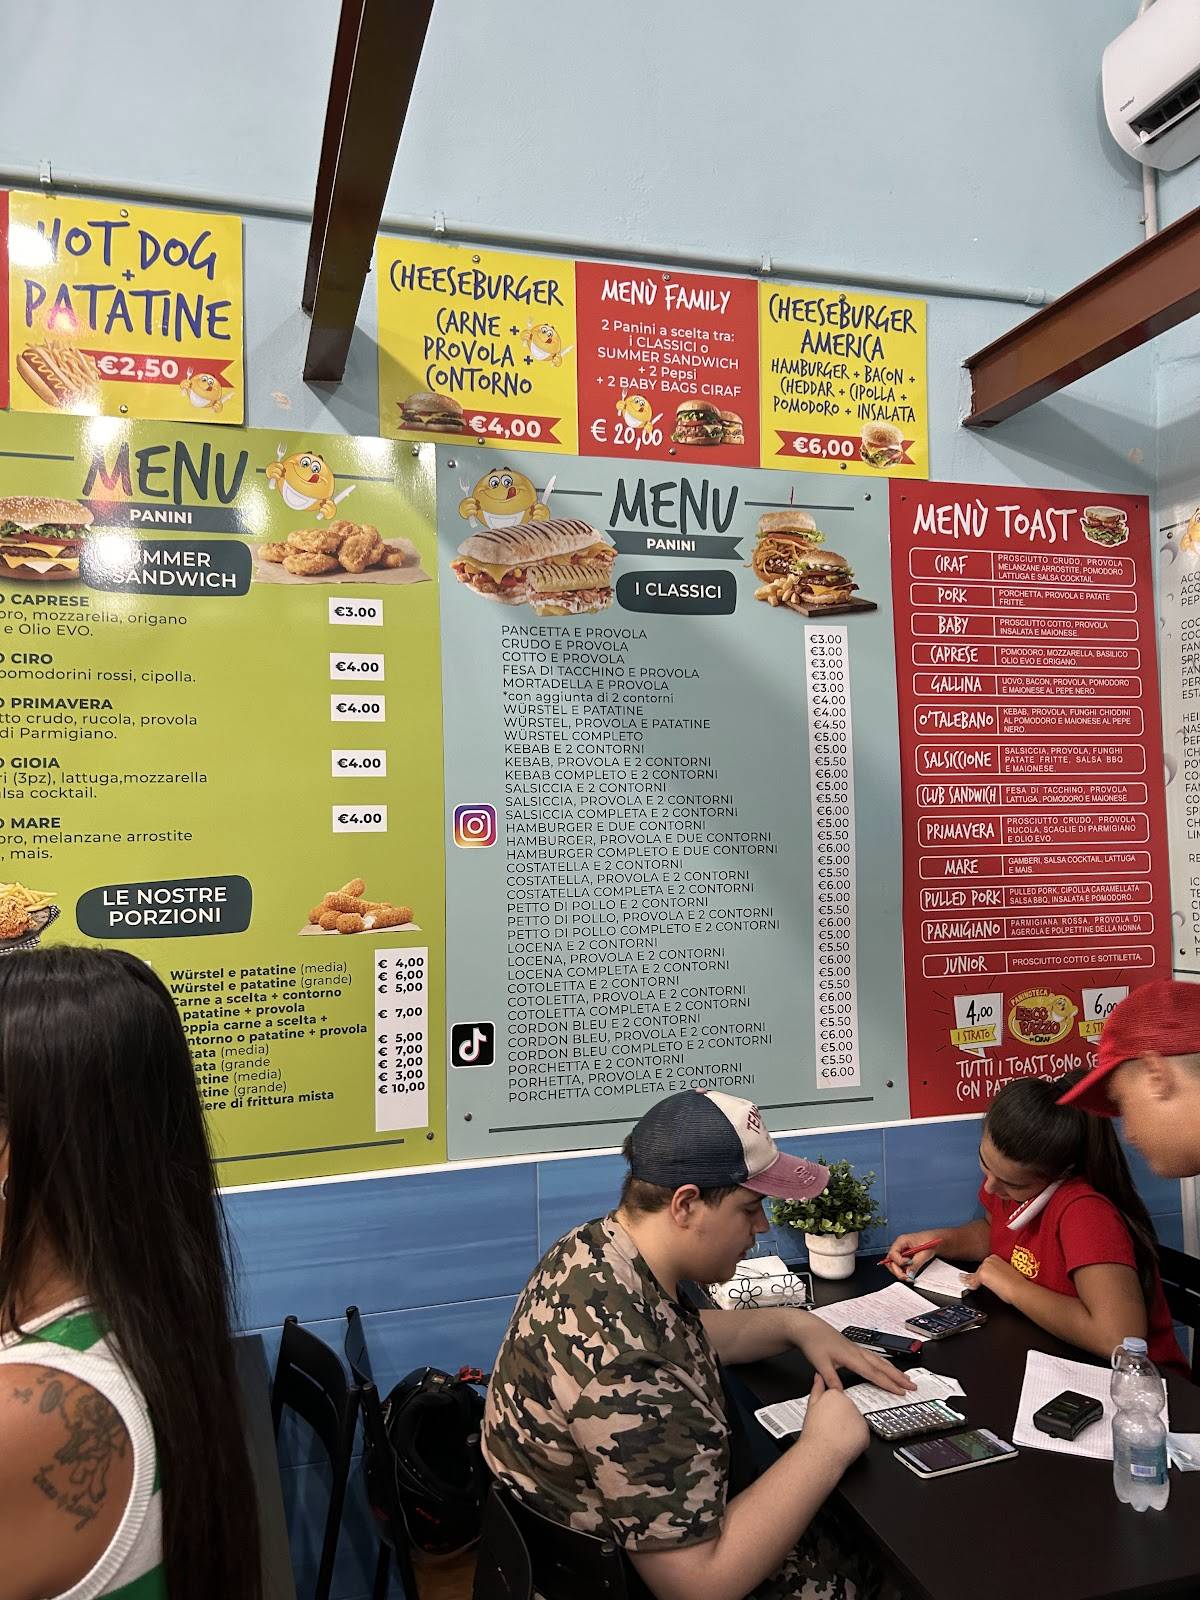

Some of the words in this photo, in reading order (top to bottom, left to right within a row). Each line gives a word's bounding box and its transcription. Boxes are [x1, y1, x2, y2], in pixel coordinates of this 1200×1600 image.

[138, 230, 217, 280] DOG
[390, 259, 564, 306] CHEESEBURGER
[602, 279, 657, 306] MENÙ
[665, 284, 730, 314] FAMILY
[24, 279, 232, 342] PATATINE
[769, 293, 917, 334] CHEESEBURGER
[437, 308, 500, 337] CARNE
[602, 319, 609, 330] 2
[614, 320, 656, 336] Panini
[660, 327, 667, 337] a
[672, 329, 709, 341] scelta
[712, 331, 734, 342] tra:
[424, 336, 514, 368] PROVOLA
[630, 335, 632, 347] i
[634, 336, 696, 352] CLASSICI
[700, 345, 708, 354] o
[801, 329, 884, 362] AMERICA
[98, 355, 178, 380] €2,50
[598, 347, 659, 363] SUMMER
[664, 353, 738, 370] SANDWICH
[426, 364, 532, 397] CONTORNO
[649, 365, 657, 377] 2
[661, 366, 696, 381] Pepsi
[772, 358, 850, 380] HAMBURGER
[865, 365, 903, 386] BACON
[608, 376, 615, 387] 2
[620, 377, 657, 390] BABY
[661, 380, 697, 394] BAGS
[701, 384, 741, 397] CIRAF
[781, 379, 835, 397] CHEDDAR
[850, 383, 895, 403] CIPOLLA
[774, 396, 840, 416] POMODORO
[858, 403, 916, 423] INSALATA
[469, 415, 541, 439] €4,00
[591, 419, 607, 442] €
[614, 423, 663, 451] 20,00
[793, 436, 854, 458] €6,00
[82, 441, 248, 505] MENU
[610, 477, 739, 535] MENU
[130, 509, 192, 524] PANINI
[913, 499, 988, 539] MENÙ
[996, 504, 1077, 543] TOAST
[646, 538, 696, 553] PANINI
[935, 554, 968, 574] CIRAF
[112, 570, 236, 588] SANDWICH
[635, 582, 639, 596] I
[644, 582, 722, 600] CLASSICI
[938, 587, 967, 602] PORK
[1045, 591, 1078, 599] PROVOLA
[1086, 592, 1110, 600] PATATE
[11, 594, 89, 607] CAPRESE
[33, 610, 122, 623] mozzarella,
[128, 613, 187, 626] origano
[335, 607, 377, 618] €3.00
[4, 625, 13, 634] e
[19, 624, 50, 635] Olio
[57, 624, 93, 637] EVO.
[502, 625, 570, 638] PANCETTA
[575, 627, 582, 638] E
[586, 628, 647, 639] PROVOLA
[938, 616, 968, 634] BABY
[810, 634, 842, 644] €3.00
[11, 653, 53, 664] CIRO
[930, 645, 978, 663] CAPRESE
[335, 662, 379, 672] €4.00
[98, 670, 136, 683] rossi,
[142, 670, 195, 684] cipolla.
[931, 675, 981, 693] GALLINA
[12, 698, 113, 710] PRIMAVERA
[536, 692, 592, 704] aggiunta
[598, 692, 608, 702] di
[613, 693, 619, 702] 2
[623, 693, 674, 703] contorni
[336, 703, 380, 713] €4.00
[26, 712, 77, 726] crudo,
[83, 713, 138, 727] rucola,
[141, 714, 196, 727] provola
[504, 717, 571, 730] WÜRSTEL,
[576, 718, 637, 730] PROVOLA
[641, 719, 648, 730] E
[653, 719, 710, 728] PATATINE
[813, 720, 846, 730] €4.50
[0, 727, 14, 739] di
[21, 727, 117, 741] Parmigiano.
[11, 758, 60, 768] GIOIA
[337, 758, 381, 768] €4.00
[924, 751, 992, 768] SALSICCIONE
[14, 772, 56, 787] (3pz),
[816, 769, 848, 779] €6.00
[30, 786, 96, 800] cocktail.
[922, 786, 945, 804] CLUB
[950, 786, 996, 804] SANDWICH
[11, 817, 60, 829] MARE
[338, 813, 382, 823] €4.00
[33, 832, 121, 844] melanzane
[127, 830, 193, 842] arrostite
[926, 823, 994, 840] PRIMAVERA
[11, 850, 52, 860] mais.
[945, 860, 978, 875] MARE
[104, 890, 130, 906] LE
[136, 887, 227, 904] NOSTRE
[925, 892, 966, 908] PULLED
[972, 890, 1001, 906] PORK
[110, 908, 220, 926] PORZIONI
[927, 922, 1000, 940] PARMIGIANO
[378, 960, 387, 969] €
[396, 958, 424, 969] 4,00
[944, 956, 987, 975] JUNIOR
[1063, 956, 1089, 964] COTTO
[170, 968, 224, 981] Würstel
[228, 970, 236, 978] e
[241, 965, 296, 979] patatine
[301, 962, 346, 977] (media)
[184, 1007, 240, 1022] patatine
[256, 1003, 305, 1017] provola
[966, 1000, 992, 1025] 4,00
[963, 1029, 990, 1040] STRATO
[588, 1070, 650, 1082] PROVOLA
[656, 1069, 661, 1078] E
[666, 1069, 672, 1078] 2
[677, 1063, 742, 1076] CONTORNI
[956, 1058, 993, 1077] TUTTI
[998, 1058, 1002, 1070] I
[1006, 1055, 1047, 1074] TOAST
[1050, 1053, 1082, 1071] SONO
[378, 1085, 388, 1094] €
[392, 1082, 425, 1094] 10,00
[957, 1081, 980, 1101] CON
